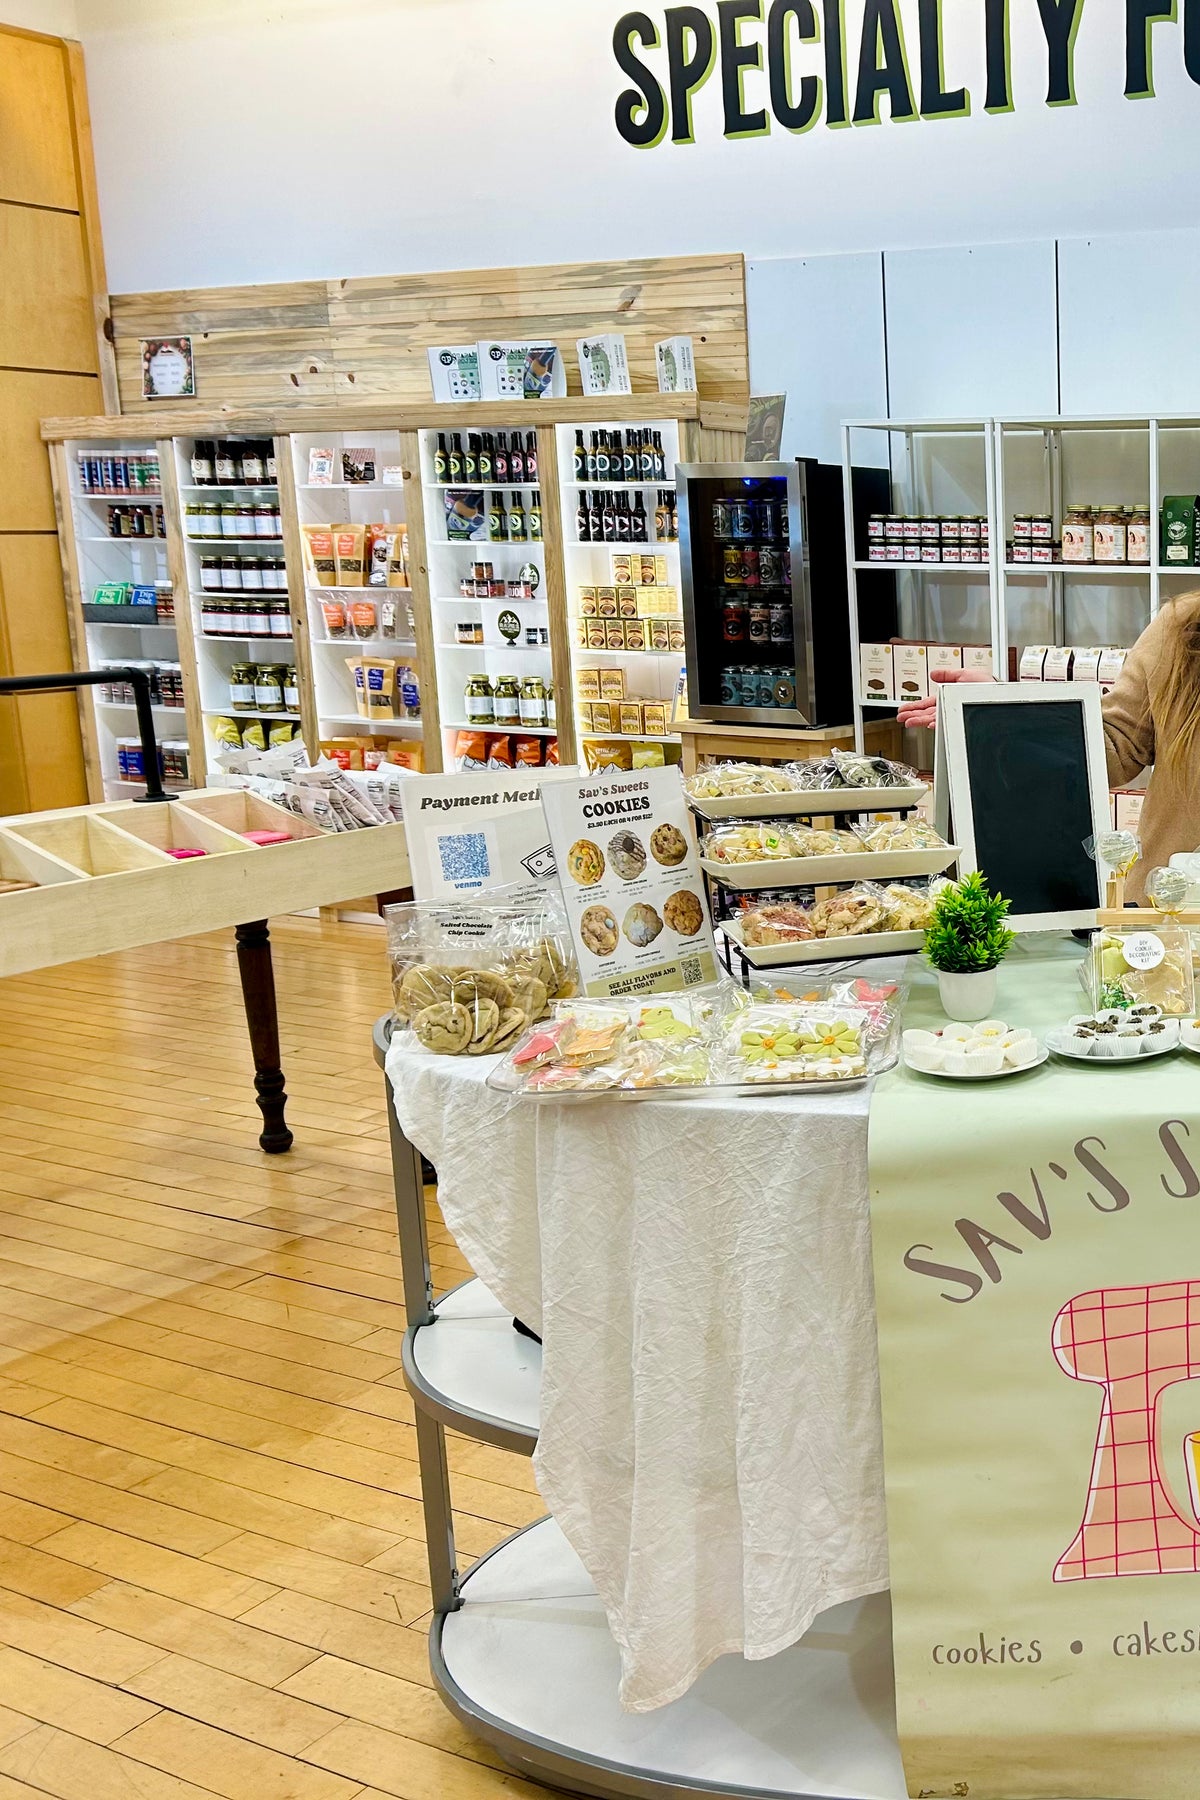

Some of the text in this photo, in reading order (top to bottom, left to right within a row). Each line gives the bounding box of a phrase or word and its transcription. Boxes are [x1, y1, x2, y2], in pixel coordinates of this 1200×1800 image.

[613, 0, 1080, 149] SPECIALTY
[578, 781, 649, 799] Sav's Sweets
[420, 792, 499, 811] Payment
[583, 796, 650, 818] COOKIES
[454, 881, 482, 889] venmo
[608, 967, 677, 991] SEE ALL FLAVORS AND
[610, 986, 632, 996] ORDER
[903, 1136, 1130, 1304] SAV'S
[932, 1632, 1043, 1665] cookies
